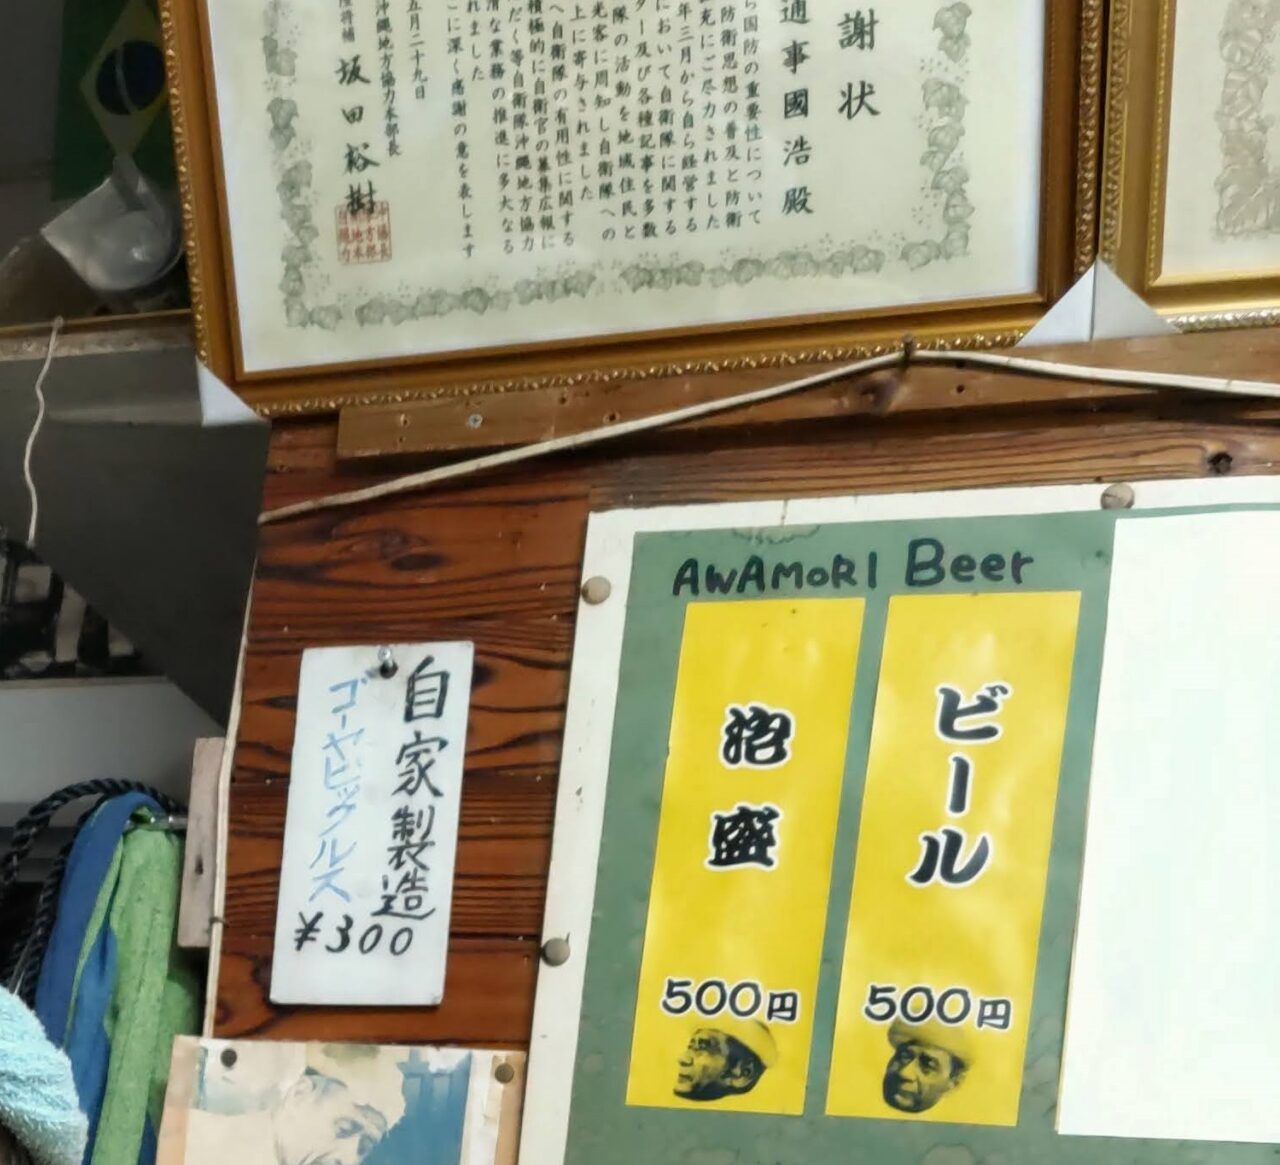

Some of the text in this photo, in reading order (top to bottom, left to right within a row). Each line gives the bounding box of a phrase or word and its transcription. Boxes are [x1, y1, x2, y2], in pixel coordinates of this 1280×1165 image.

[699, 0, 720, 230] 充にご尽力されました
[836, 9, 881, 120] 謝状
[905, 537, 1035, 587] Beer
[369, 655, 450, 921] 自家製造
[707, 704, 792, 868] 泡盛
[910, 685, 1009, 886] ビール
[294, 910, 415, 956] ¥300
[661, 977, 800, 1022] 500円
[864, 983, 1013, 1030] 500円
